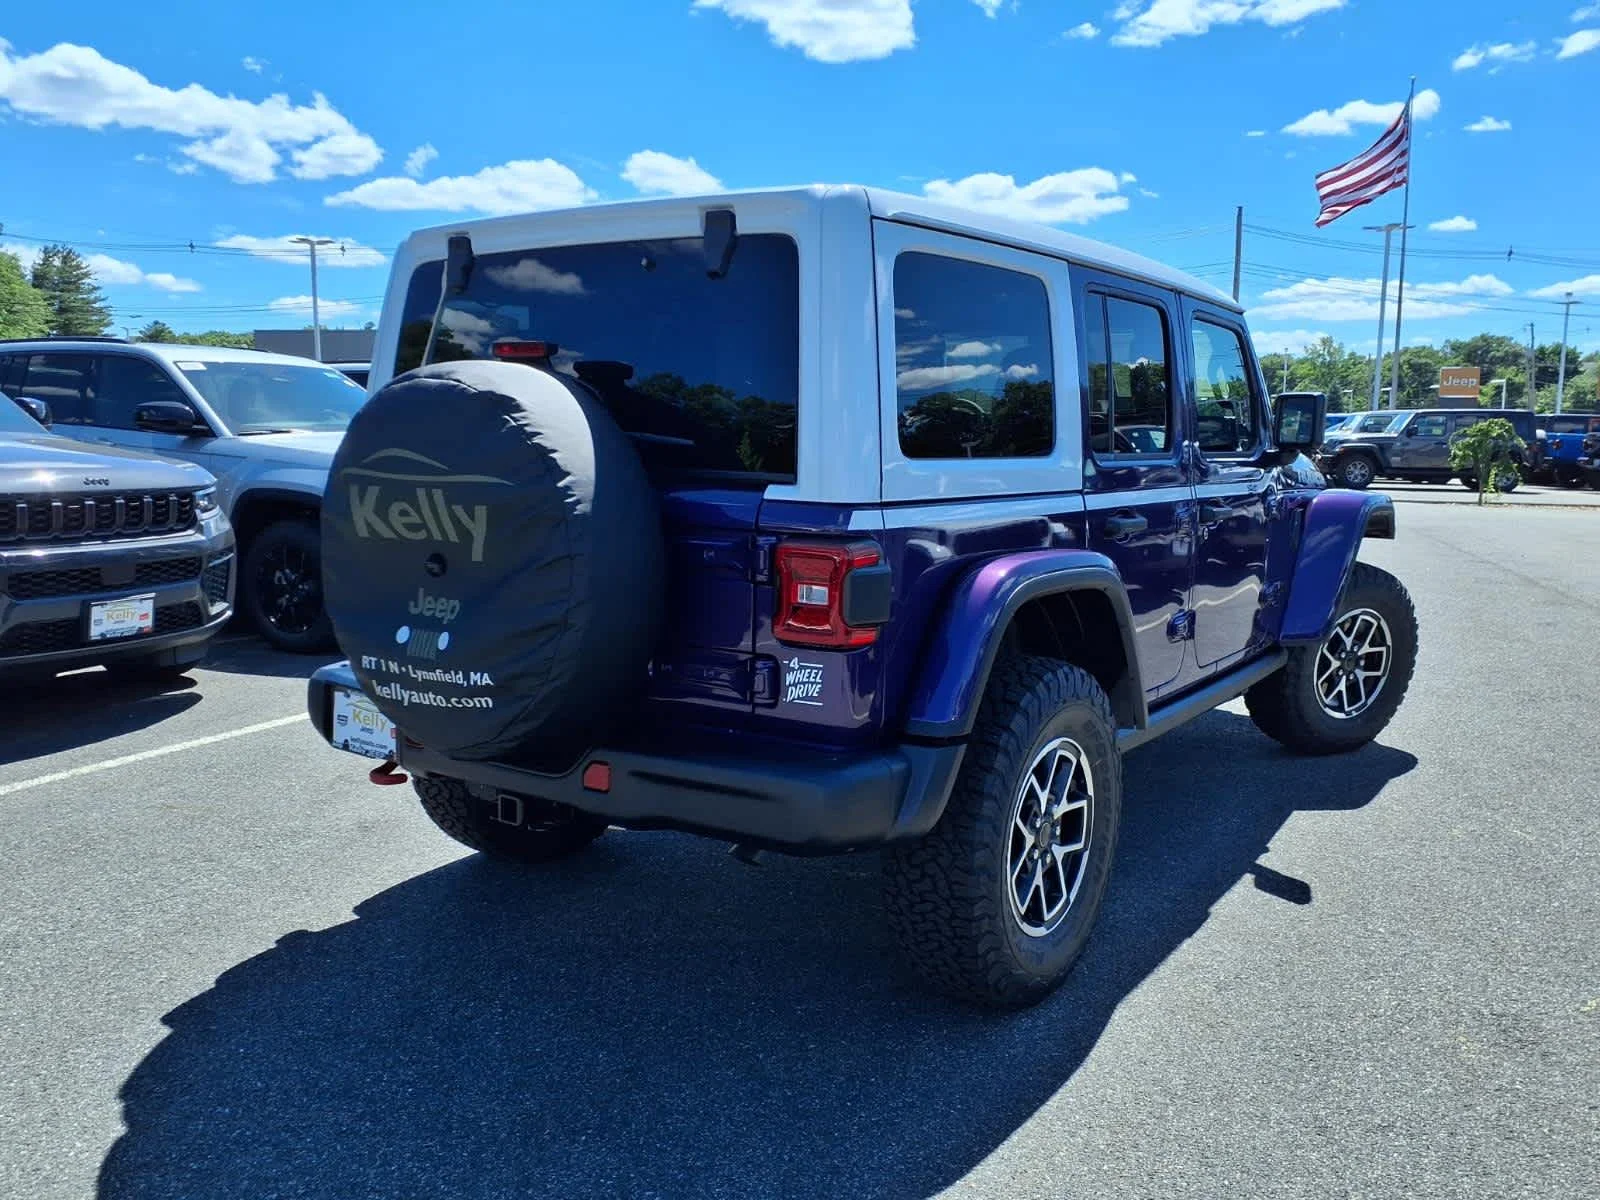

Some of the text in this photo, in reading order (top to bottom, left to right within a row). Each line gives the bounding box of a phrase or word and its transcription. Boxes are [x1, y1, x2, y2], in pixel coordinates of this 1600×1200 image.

[1443, 376, 1477, 388] Jeep
[349, 484, 487, 562] Kelly
[105, 607, 135, 620] Kelly
[408, 587, 460, 624] Jeep
[361, 655, 378, 670] RT
[388, 661, 400, 674] N
[408, 664, 468, 687] Lynnfield,
[469, 671, 495, 686] MA
[789, 656, 799, 670] 4
[785, 668, 823, 686] WHEEL
[371, 679, 494, 709] kellyauto.com
[786, 683, 822, 702] DRIVE
[352, 709, 387, 732] Kelly
